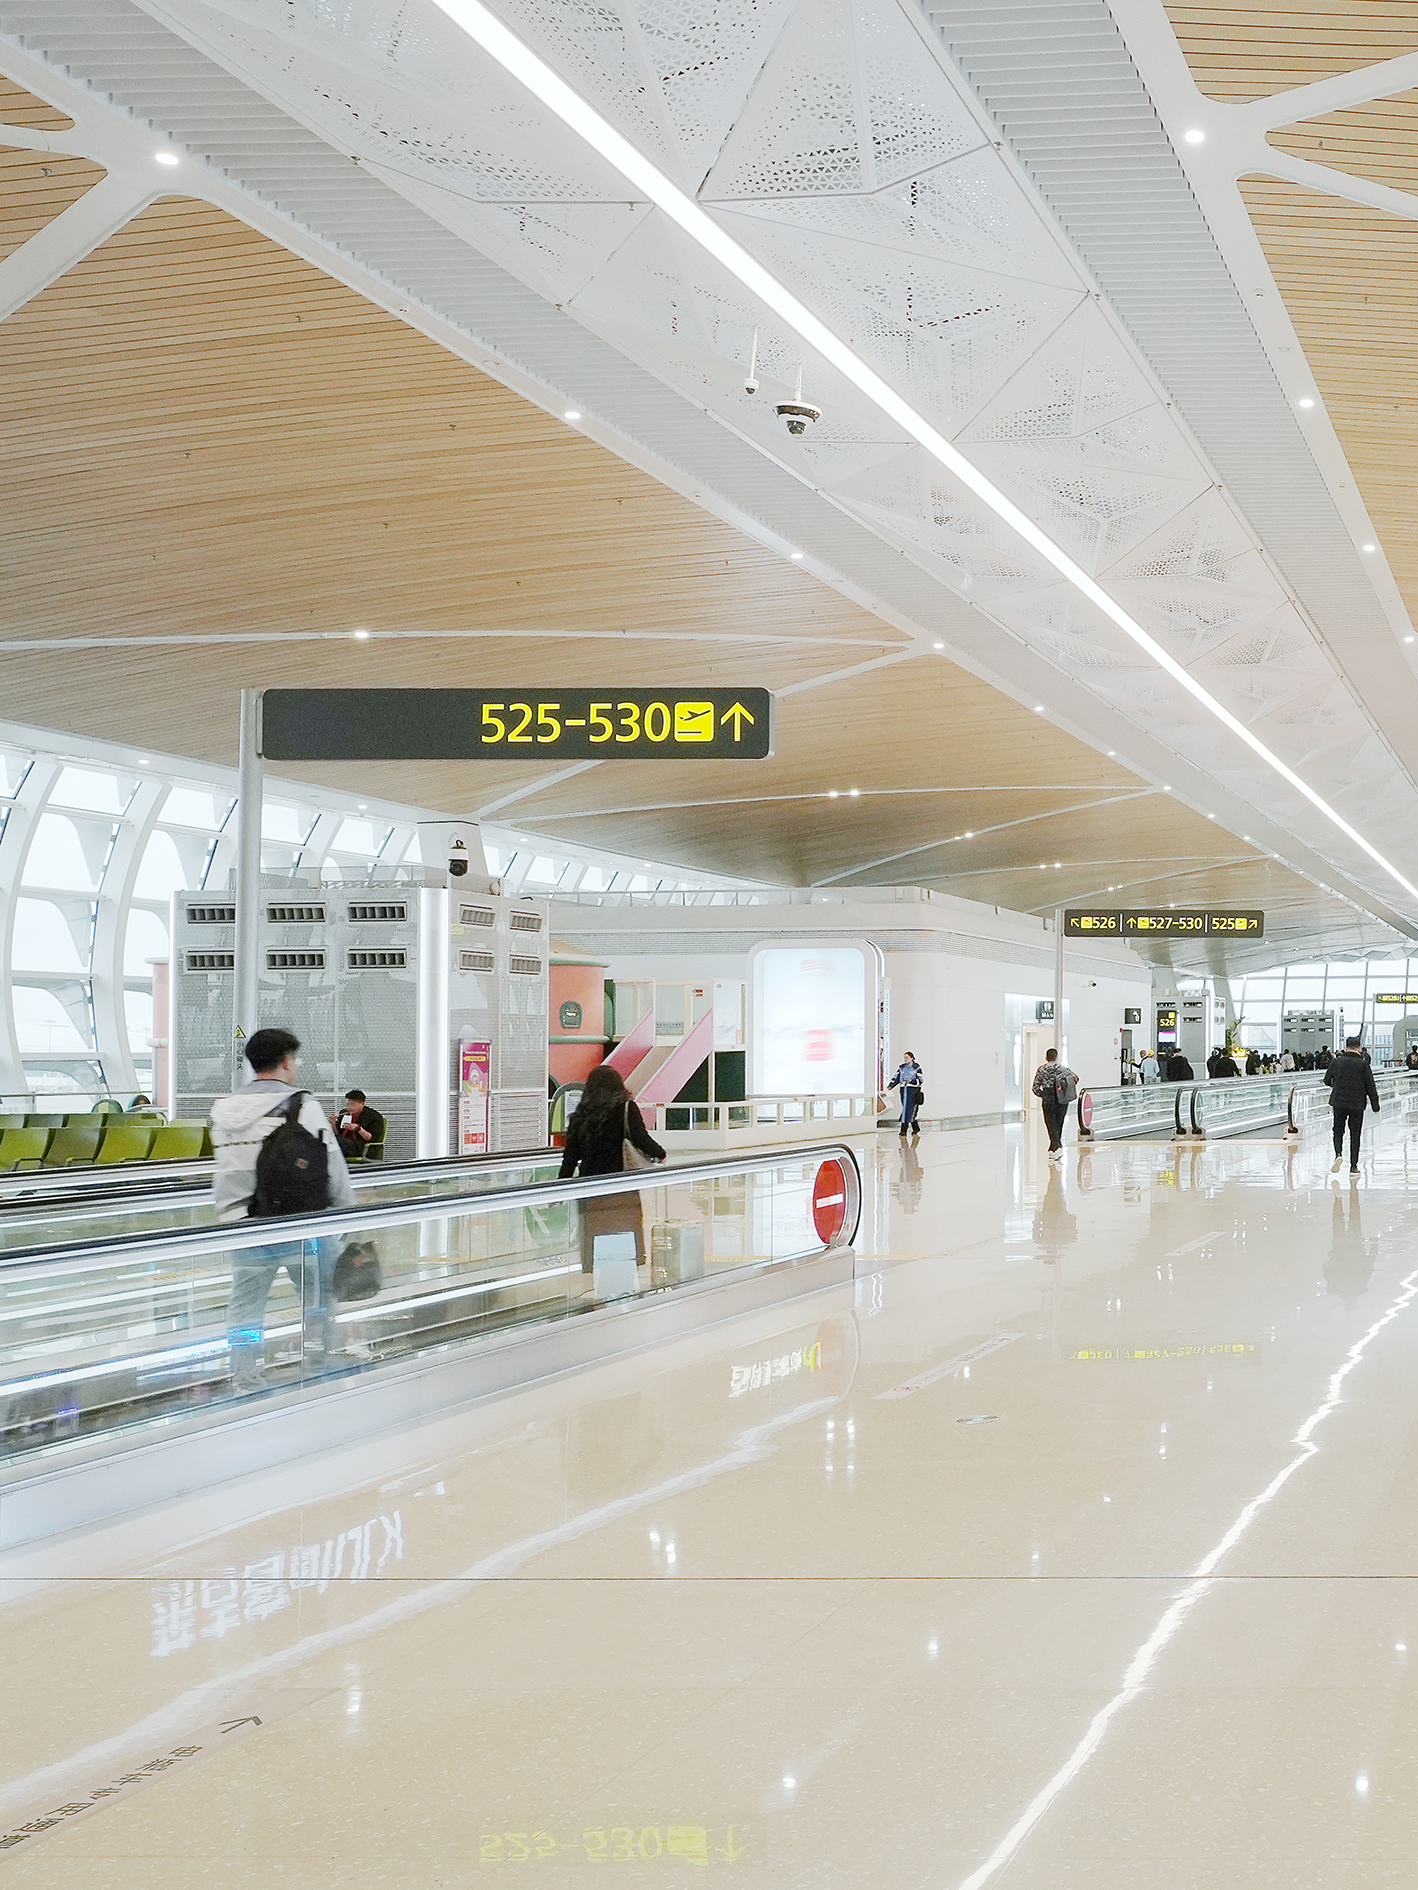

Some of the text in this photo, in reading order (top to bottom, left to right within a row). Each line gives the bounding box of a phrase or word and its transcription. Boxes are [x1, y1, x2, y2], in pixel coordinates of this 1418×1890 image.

[480, 701, 672, 744] 525-530
[1092, 916, 1117, 930] 526
[1149, 917, 1203, 931] 527-530
[1211, 917, 1236, 931] 525
[1160, 1018, 1175, 1027] 526
